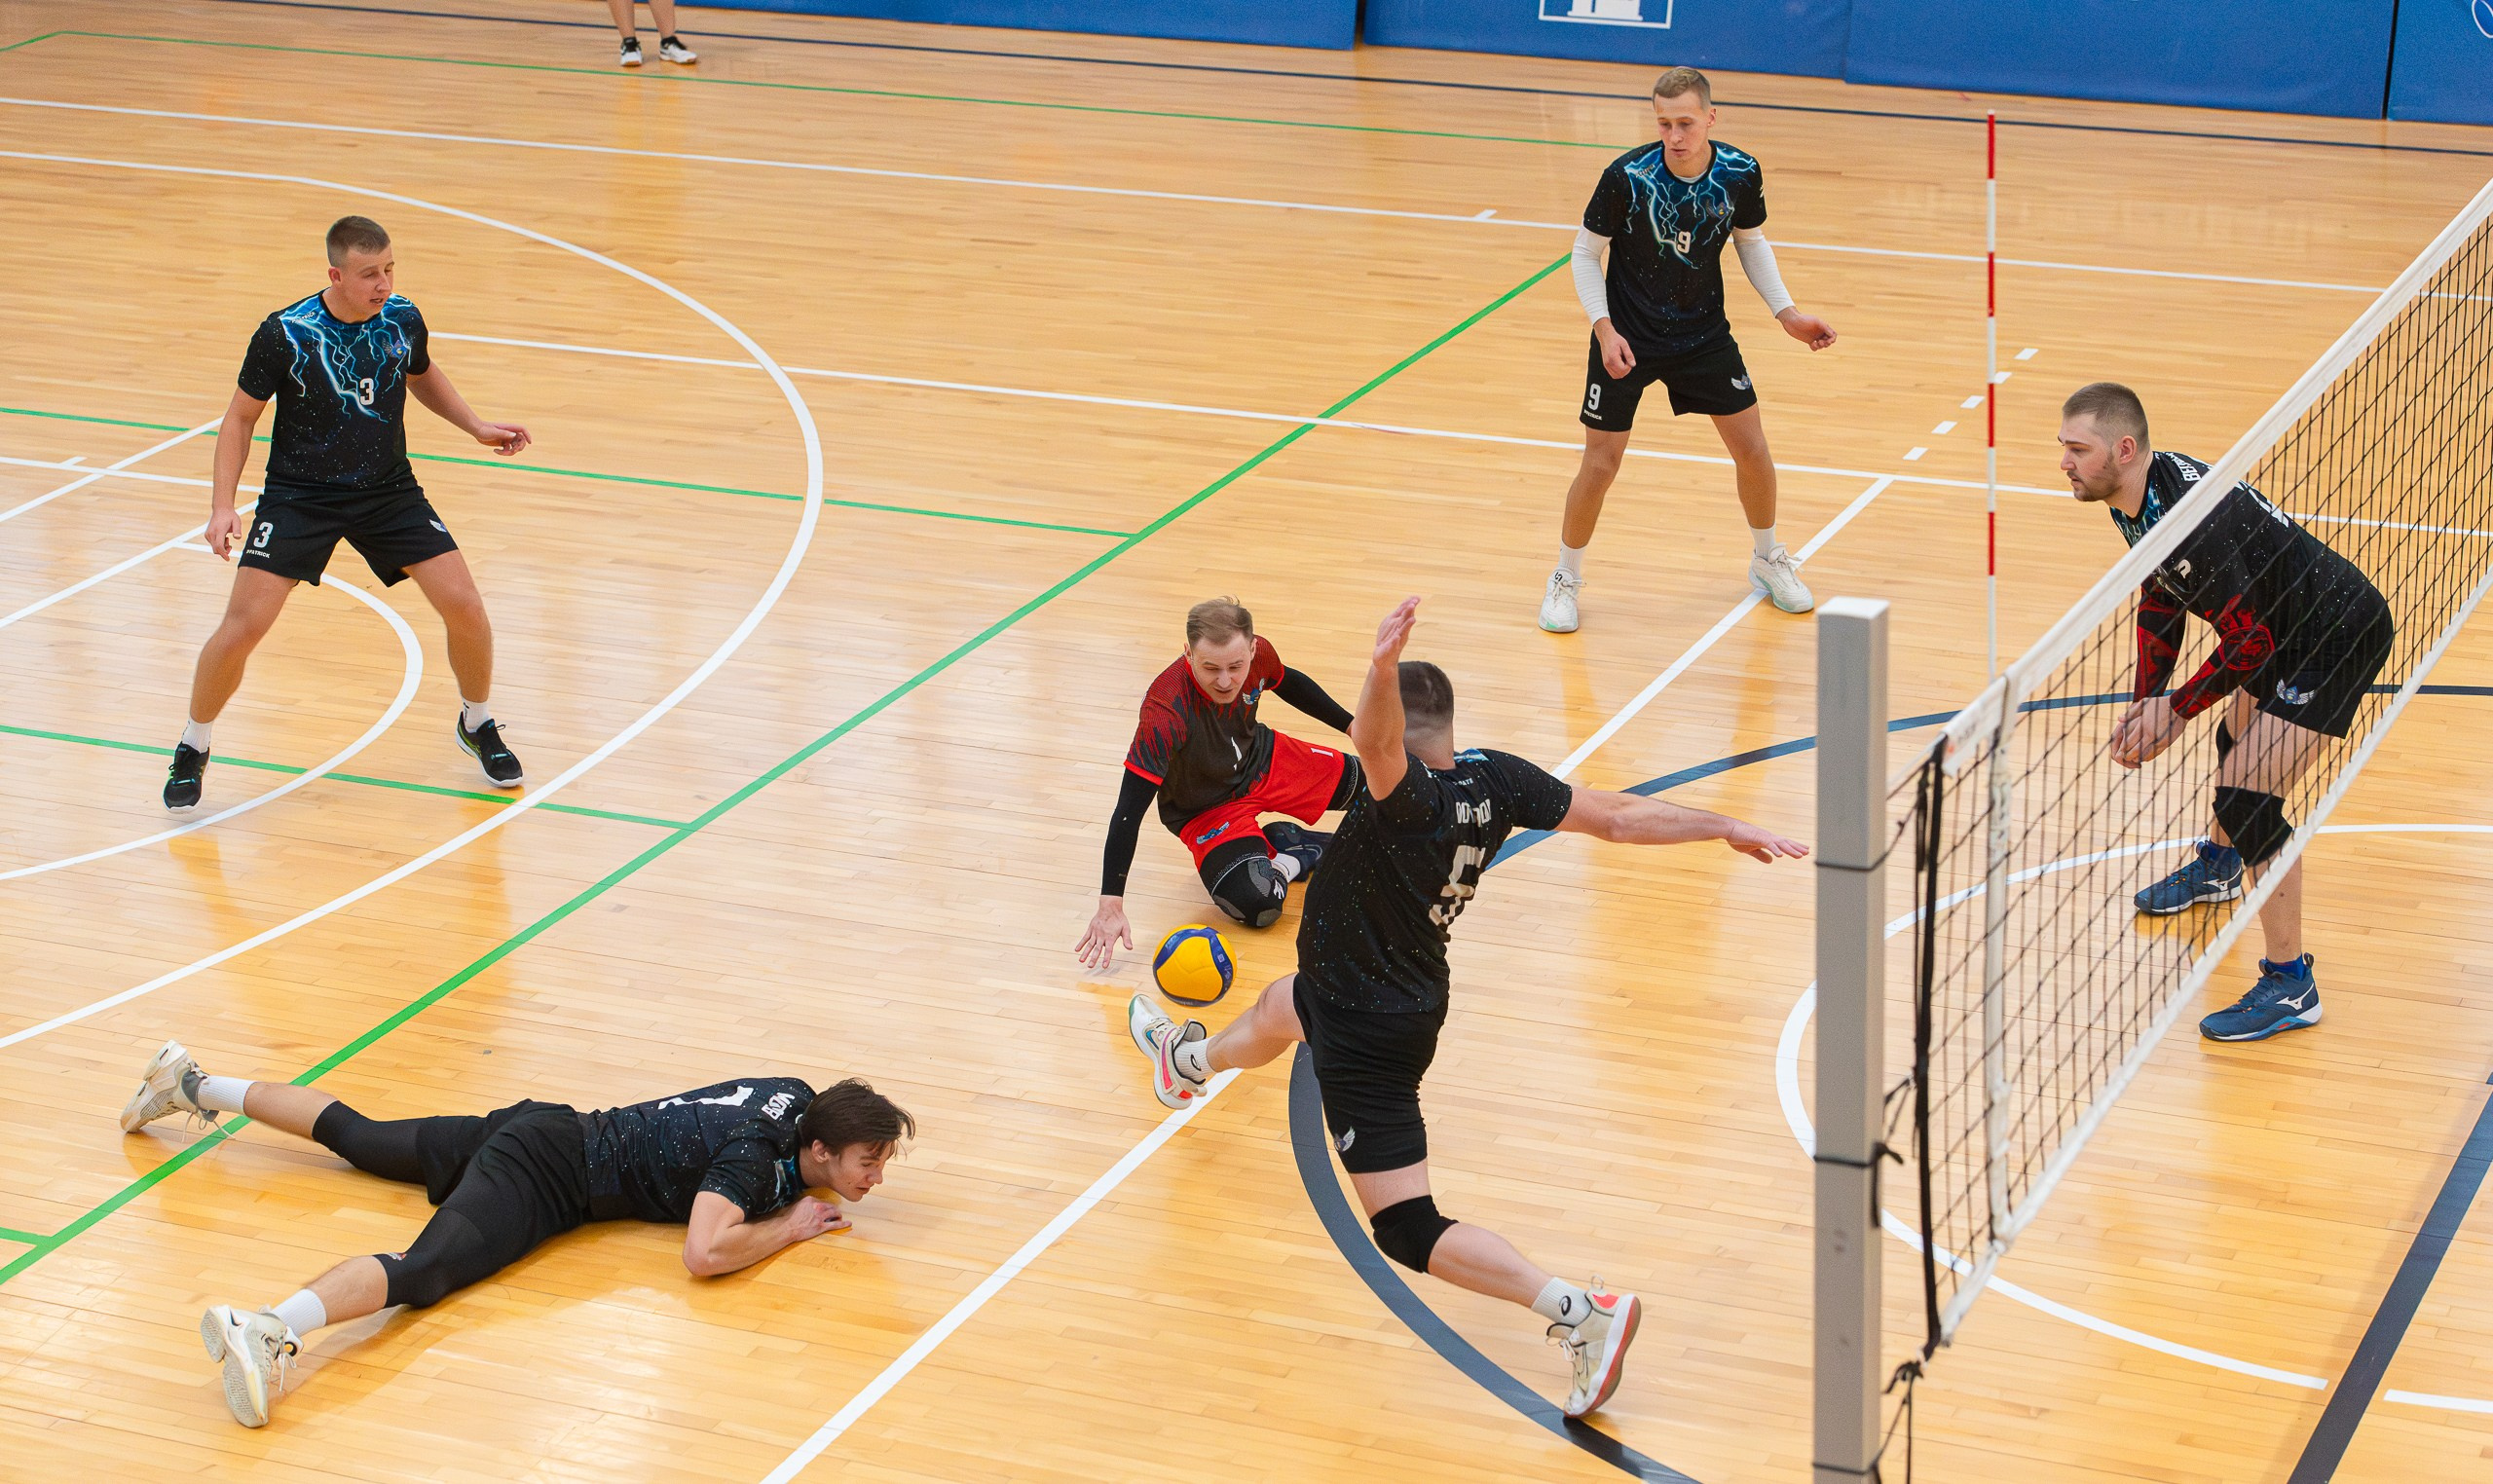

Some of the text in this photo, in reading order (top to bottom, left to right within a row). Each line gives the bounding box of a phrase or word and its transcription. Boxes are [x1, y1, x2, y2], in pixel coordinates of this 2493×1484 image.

[1677, 231, 1692, 254] 9
[359, 377, 375, 406] 3
[1587, 383, 1602, 411] 9
[253, 521, 274, 548] 3
